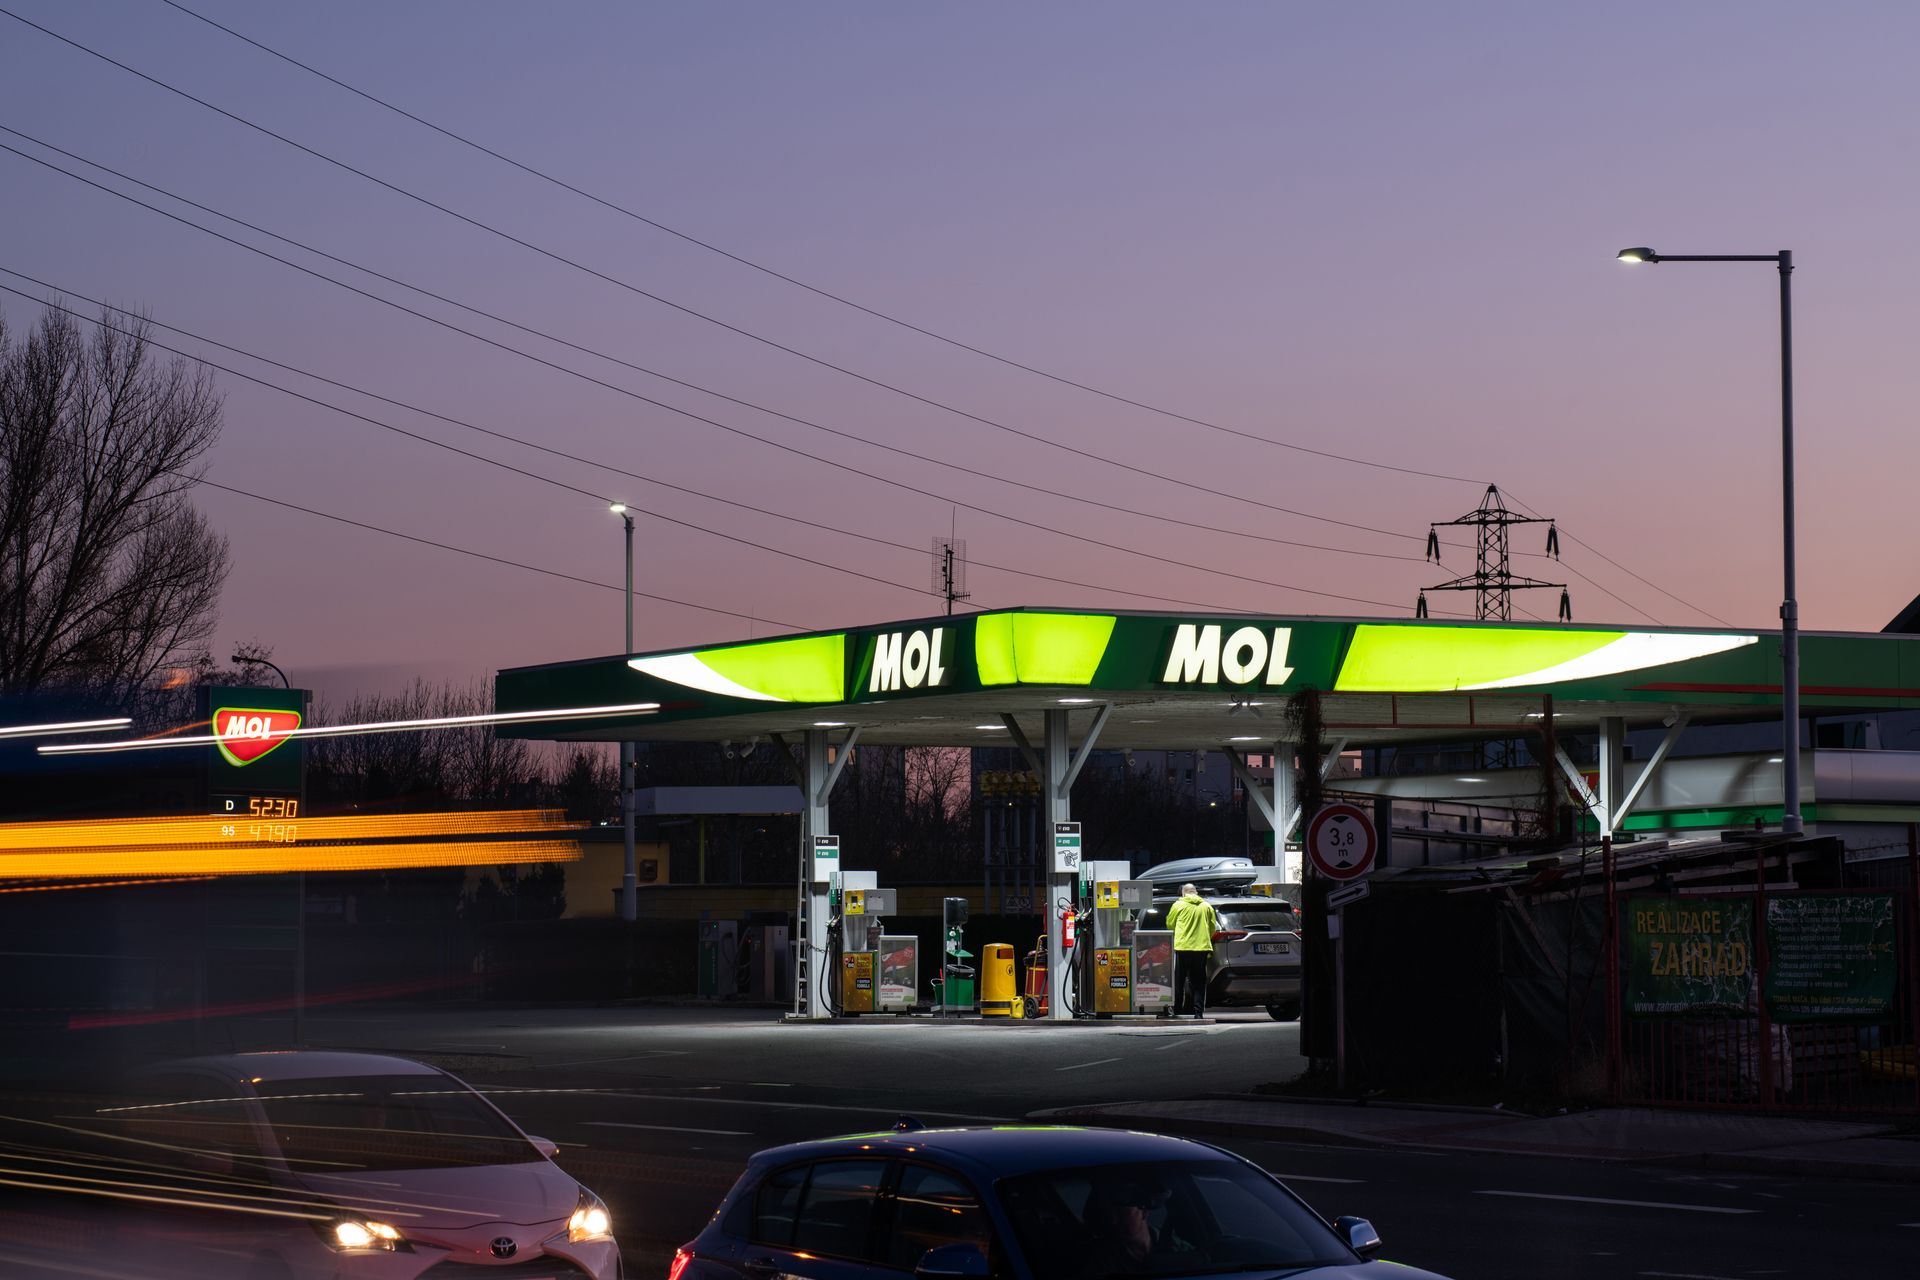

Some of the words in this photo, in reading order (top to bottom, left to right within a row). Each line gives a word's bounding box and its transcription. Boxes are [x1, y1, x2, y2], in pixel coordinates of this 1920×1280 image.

[869, 627, 945, 693] MOL
[1163, 624, 1295, 685] MOL
[224, 715, 272, 740] MOL
[225, 800, 234, 811] D
[221, 825, 236, 837] 95
[1329, 827, 1354, 847] 3,8
[1338, 848, 1348, 857] m
[1636, 910, 1722, 934] REALIZACE
[1650, 942, 1747, 977] ZAHRAD
